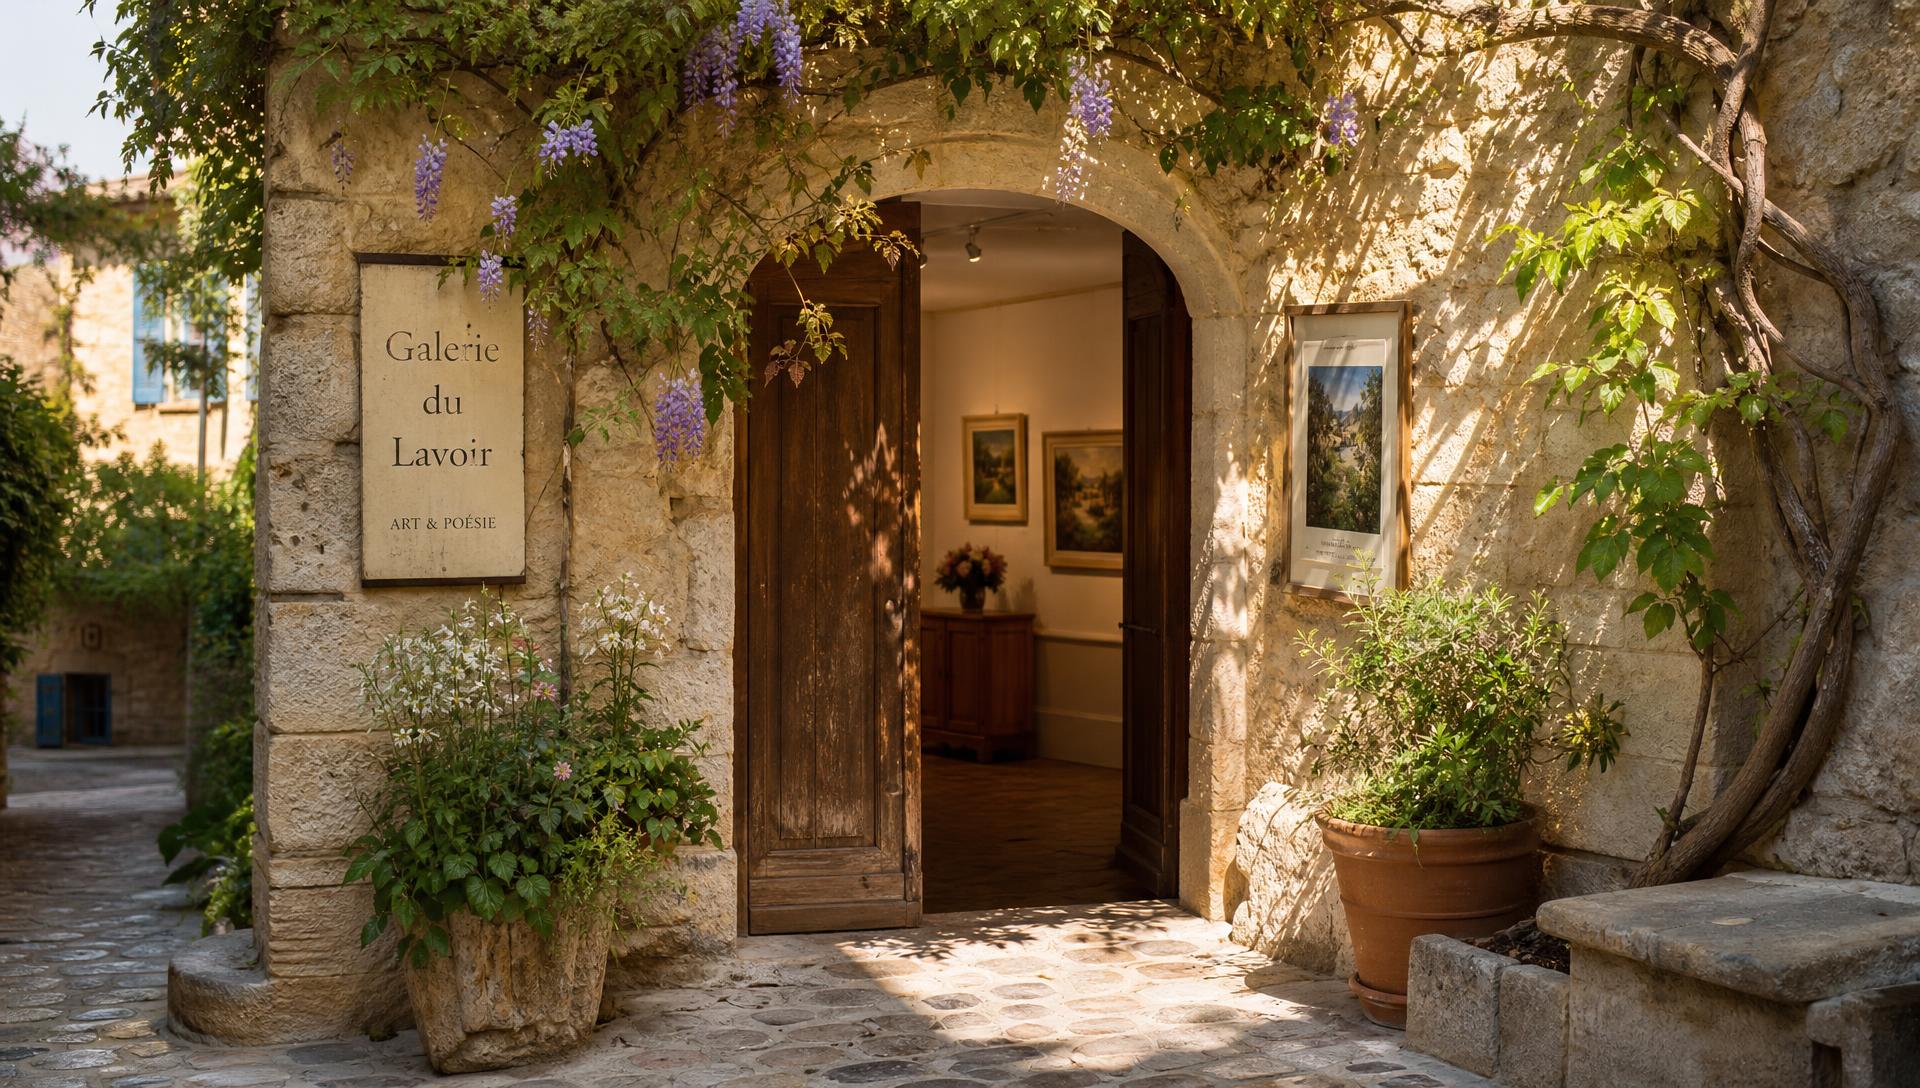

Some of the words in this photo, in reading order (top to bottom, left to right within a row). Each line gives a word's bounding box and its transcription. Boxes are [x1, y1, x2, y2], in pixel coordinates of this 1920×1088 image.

[386, 330, 500, 363] Galerie
[422, 383, 463, 415] du
[391, 436, 493, 468] Lavoir
[390, 517, 421, 531] ART
[426, 517, 438, 530] &
[443, 513, 497, 530] POÉSIE
